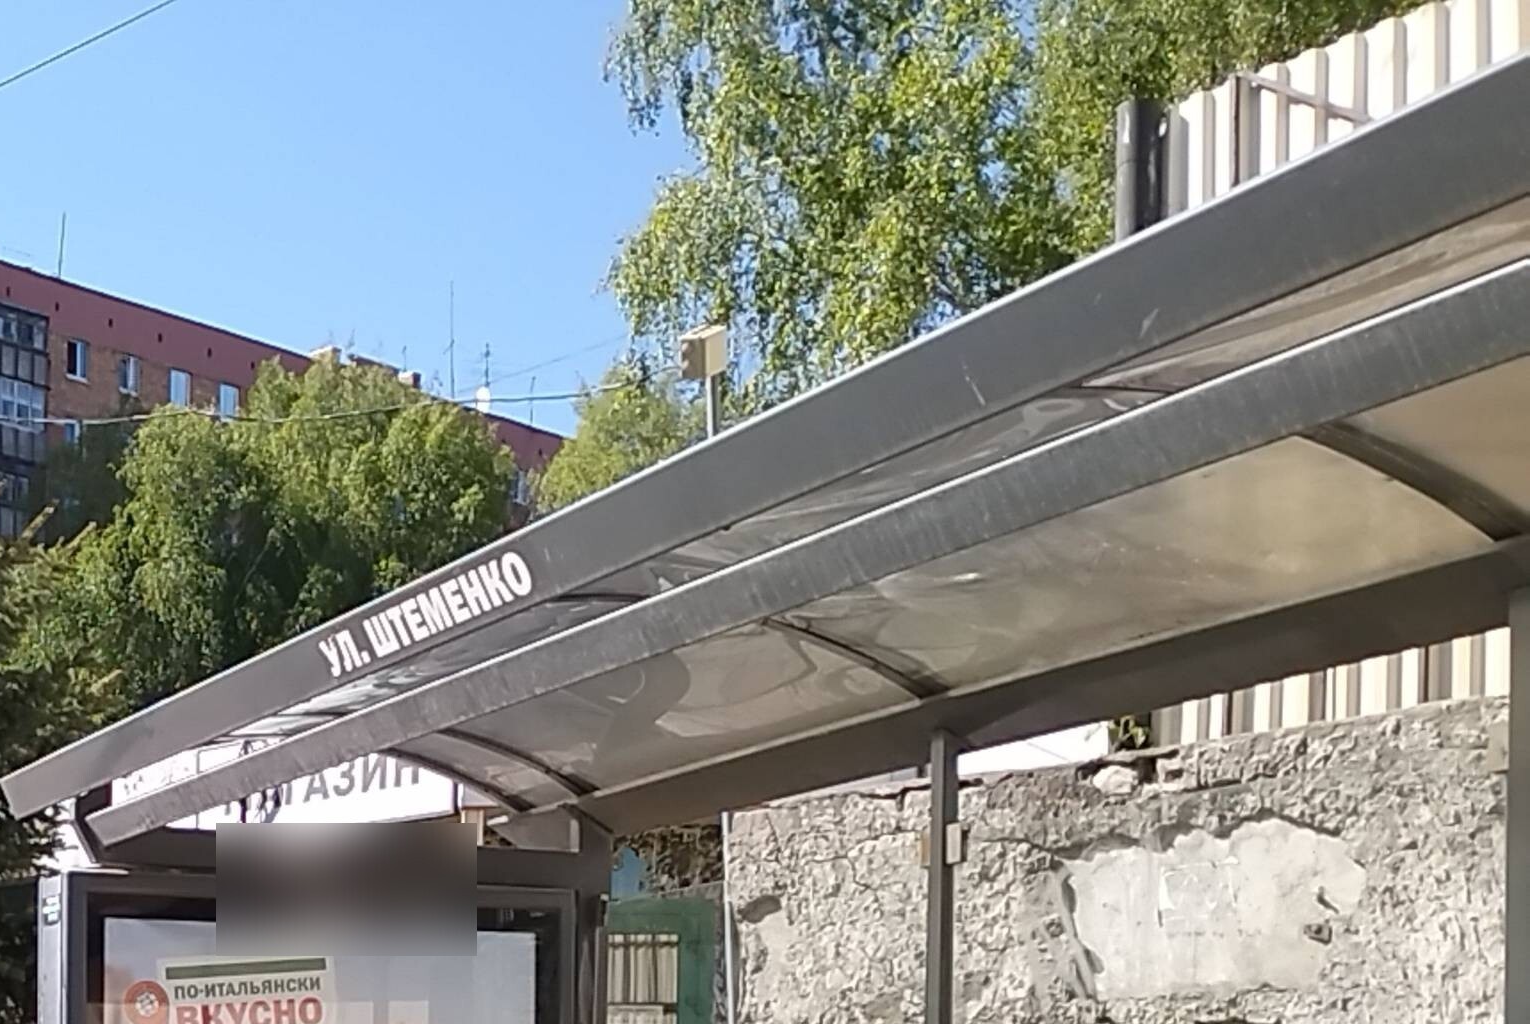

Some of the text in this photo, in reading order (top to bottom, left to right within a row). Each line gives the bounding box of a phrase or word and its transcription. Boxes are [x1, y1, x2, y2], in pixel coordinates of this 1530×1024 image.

[319, 552, 532, 677] УЛ. ШТЕМЕНКО
[174, 977, 320, 1000] ПО-ИТАЛЬЯНСКИ
